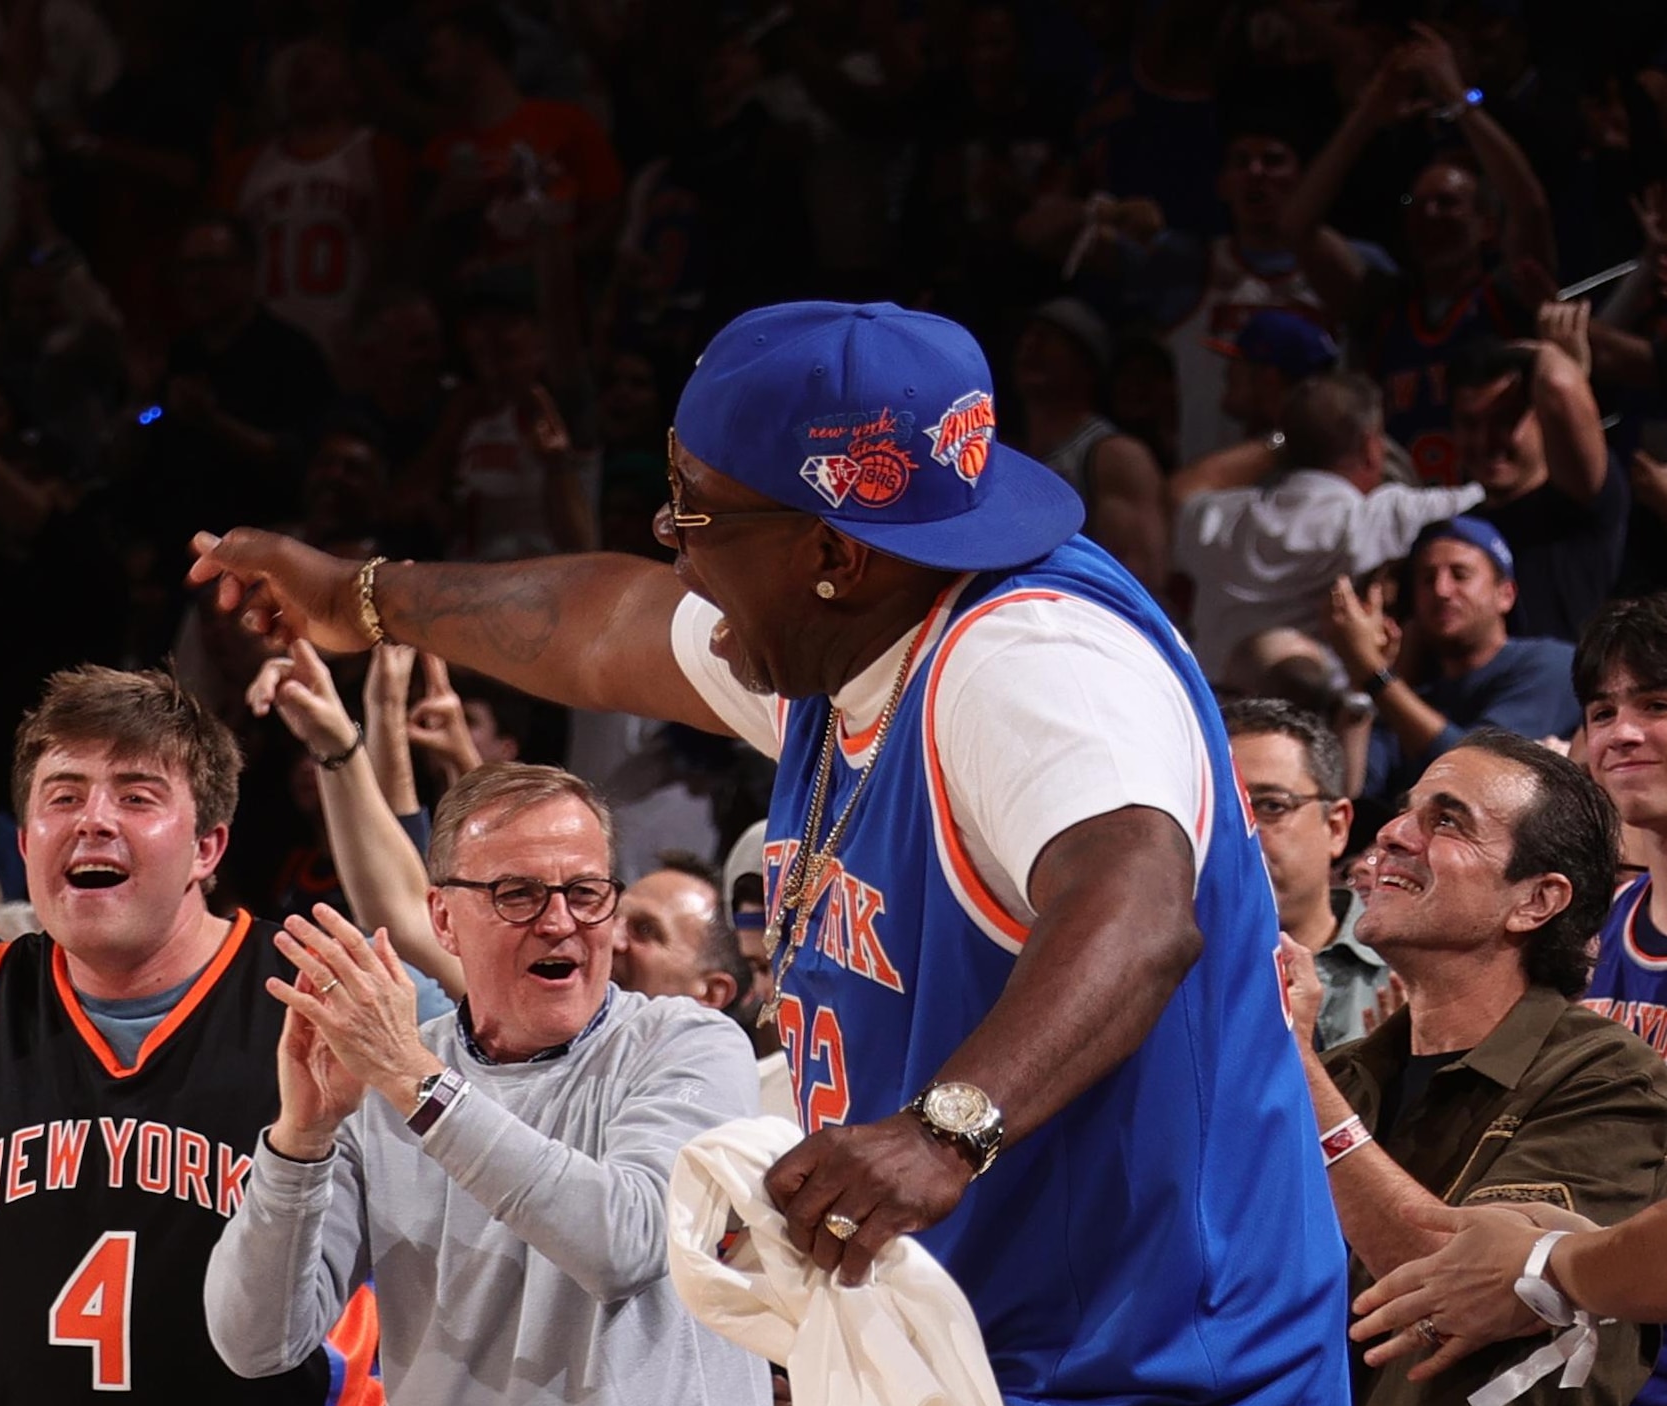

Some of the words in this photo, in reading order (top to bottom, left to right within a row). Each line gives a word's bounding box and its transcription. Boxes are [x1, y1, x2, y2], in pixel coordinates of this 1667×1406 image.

[265, 224, 346, 297] 10
[99, 1117, 255, 1218] YORK
[48, 1230, 137, 1391] 4
